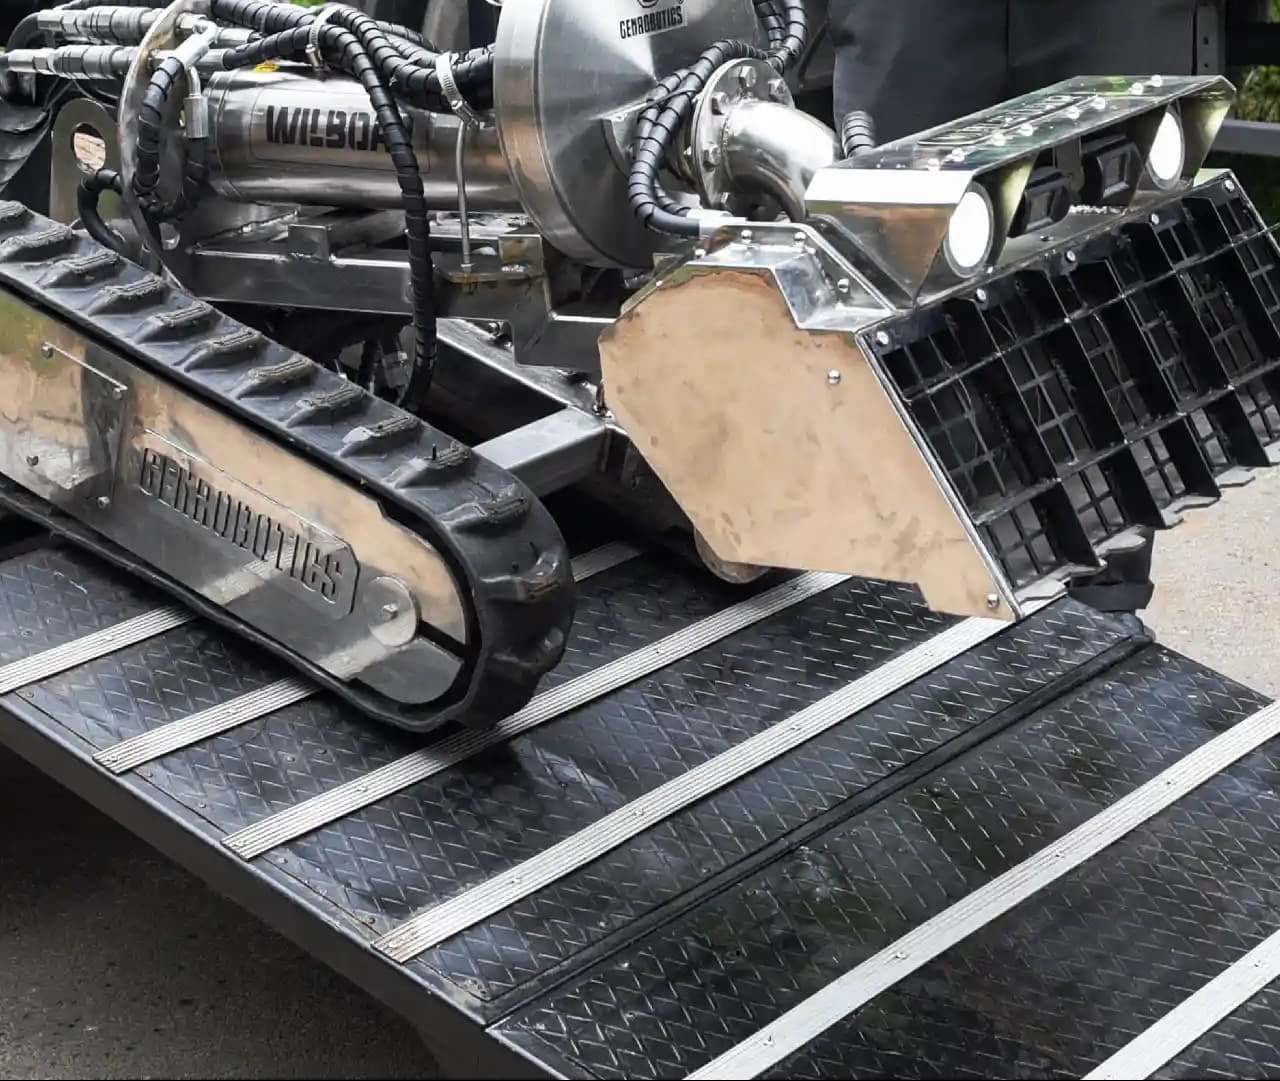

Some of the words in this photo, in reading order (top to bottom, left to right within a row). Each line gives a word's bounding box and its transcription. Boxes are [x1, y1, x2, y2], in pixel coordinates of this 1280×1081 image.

[619, 5, 684, 39] GENROBOTICS
[266, 104, 414, 153] WILBOA
[140, 447, 344, 605] GENROBOTICS
